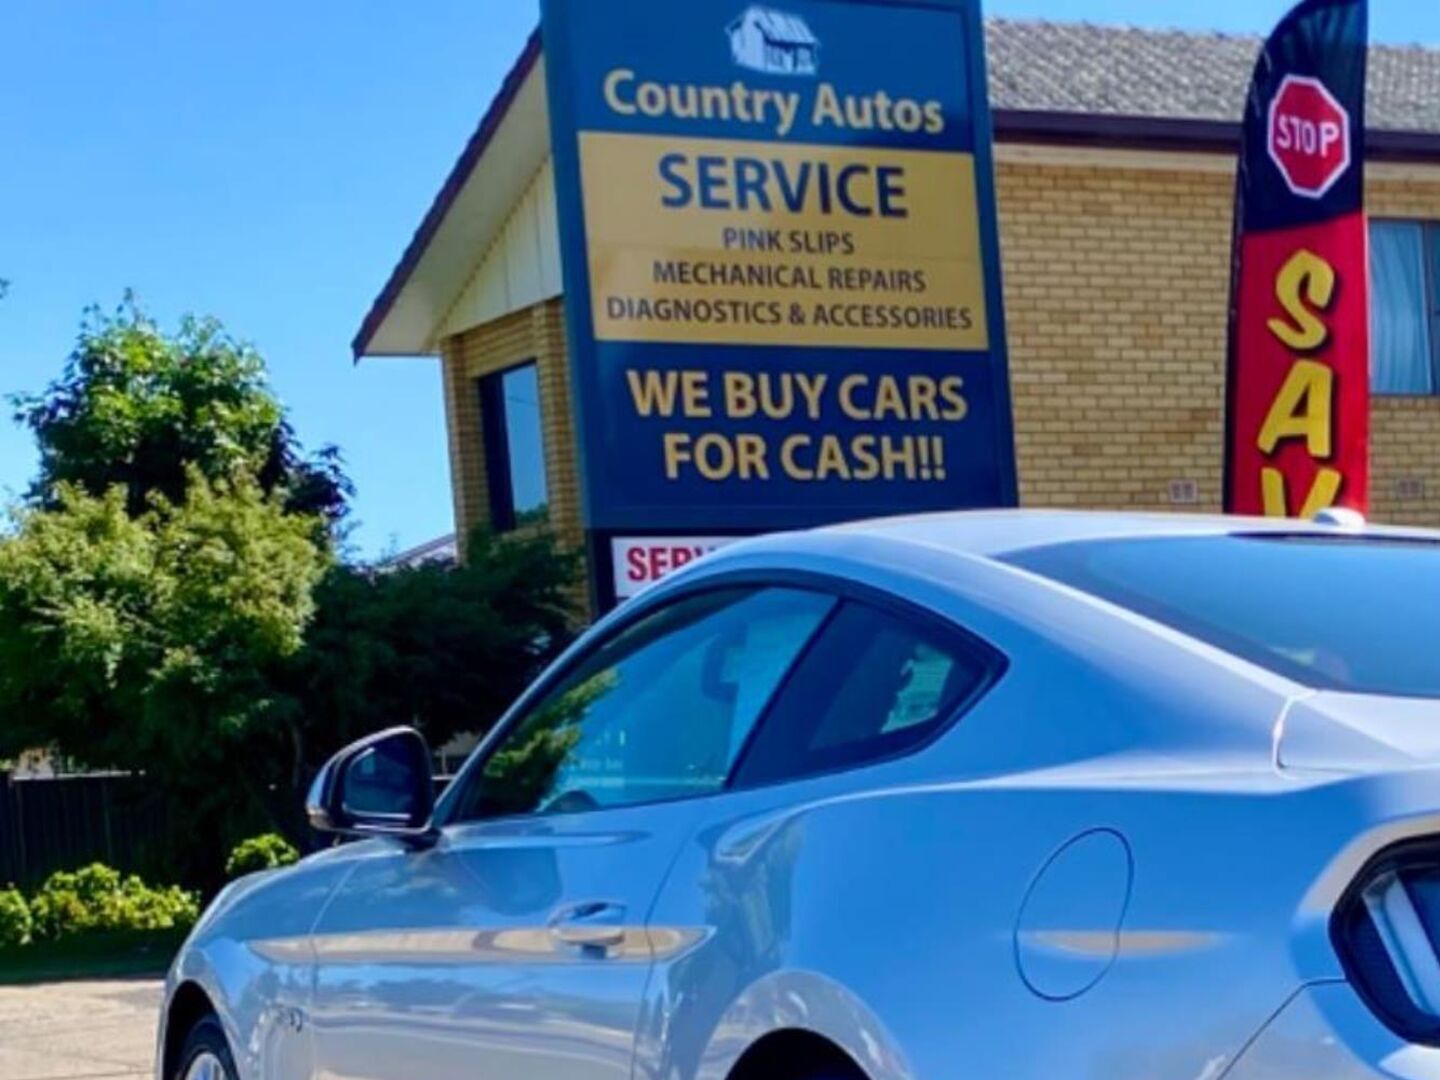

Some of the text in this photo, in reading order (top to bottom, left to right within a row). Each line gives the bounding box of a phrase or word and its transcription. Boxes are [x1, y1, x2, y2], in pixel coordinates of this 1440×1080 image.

[604, 68, 944, 136] Country Autos
[1277, 114, 1340, 158] STOP
[658, 153, 908, 218] SERVICE
[722, 227, 855, 255] PINK SLIPS
[653, 261, 926, 293] MECHANICAL REPAIRS
[606, 296, 973, 330] DIAGNOSTICS & ACCESSORIES
[626, 370, 968, 421] WE BUY CARS
[663, 432, 946, 481] FOR CASH!!
